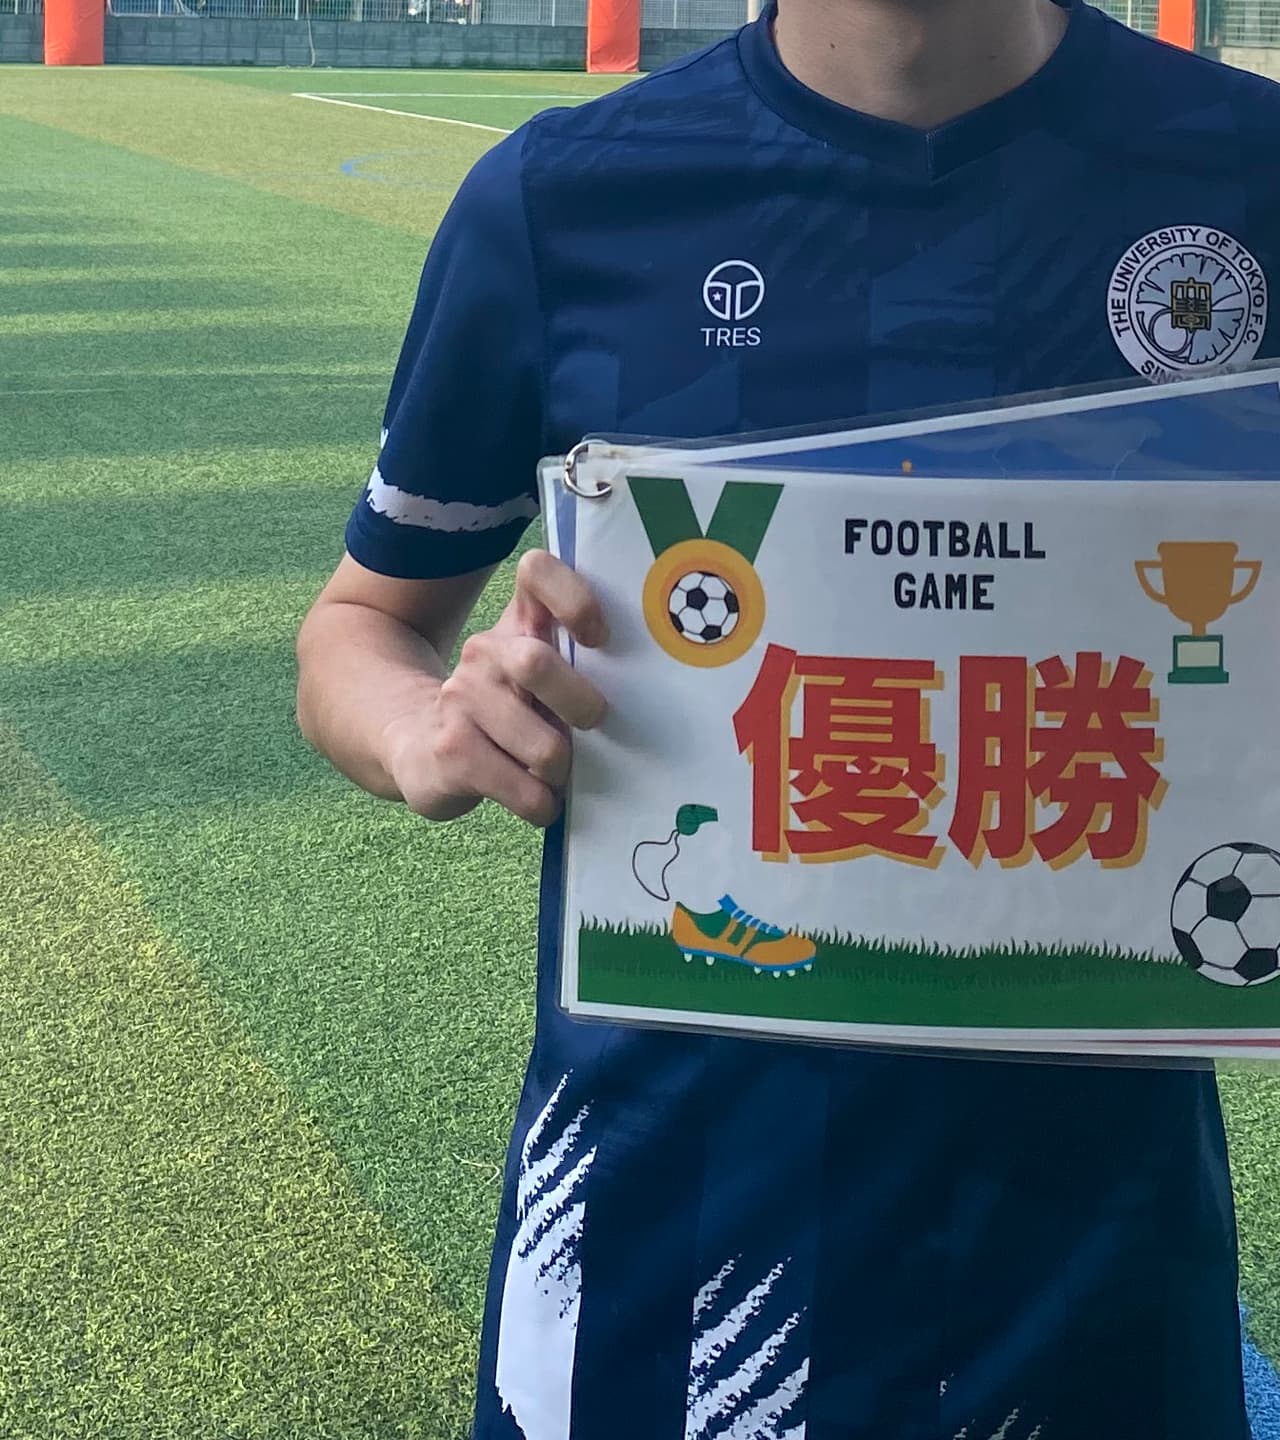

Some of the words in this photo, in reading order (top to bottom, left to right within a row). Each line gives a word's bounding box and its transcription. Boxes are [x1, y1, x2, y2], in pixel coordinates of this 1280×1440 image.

[1206, 231, 1232, 249] OF
[1112, 227, 1201, 293] UNIVERSITY
[1230, 246, 1265, 308] TOKYO
[700, 327, 761, 347] TRES
[1111, 298, 1131, 337] THE
[1243, 313, 1263, 345] F.C.
[844, 518, 1047, 559] FOOTBALL
[893, 572, 995, 611] GAME
[732, 643, 1169, 869] 優勝
